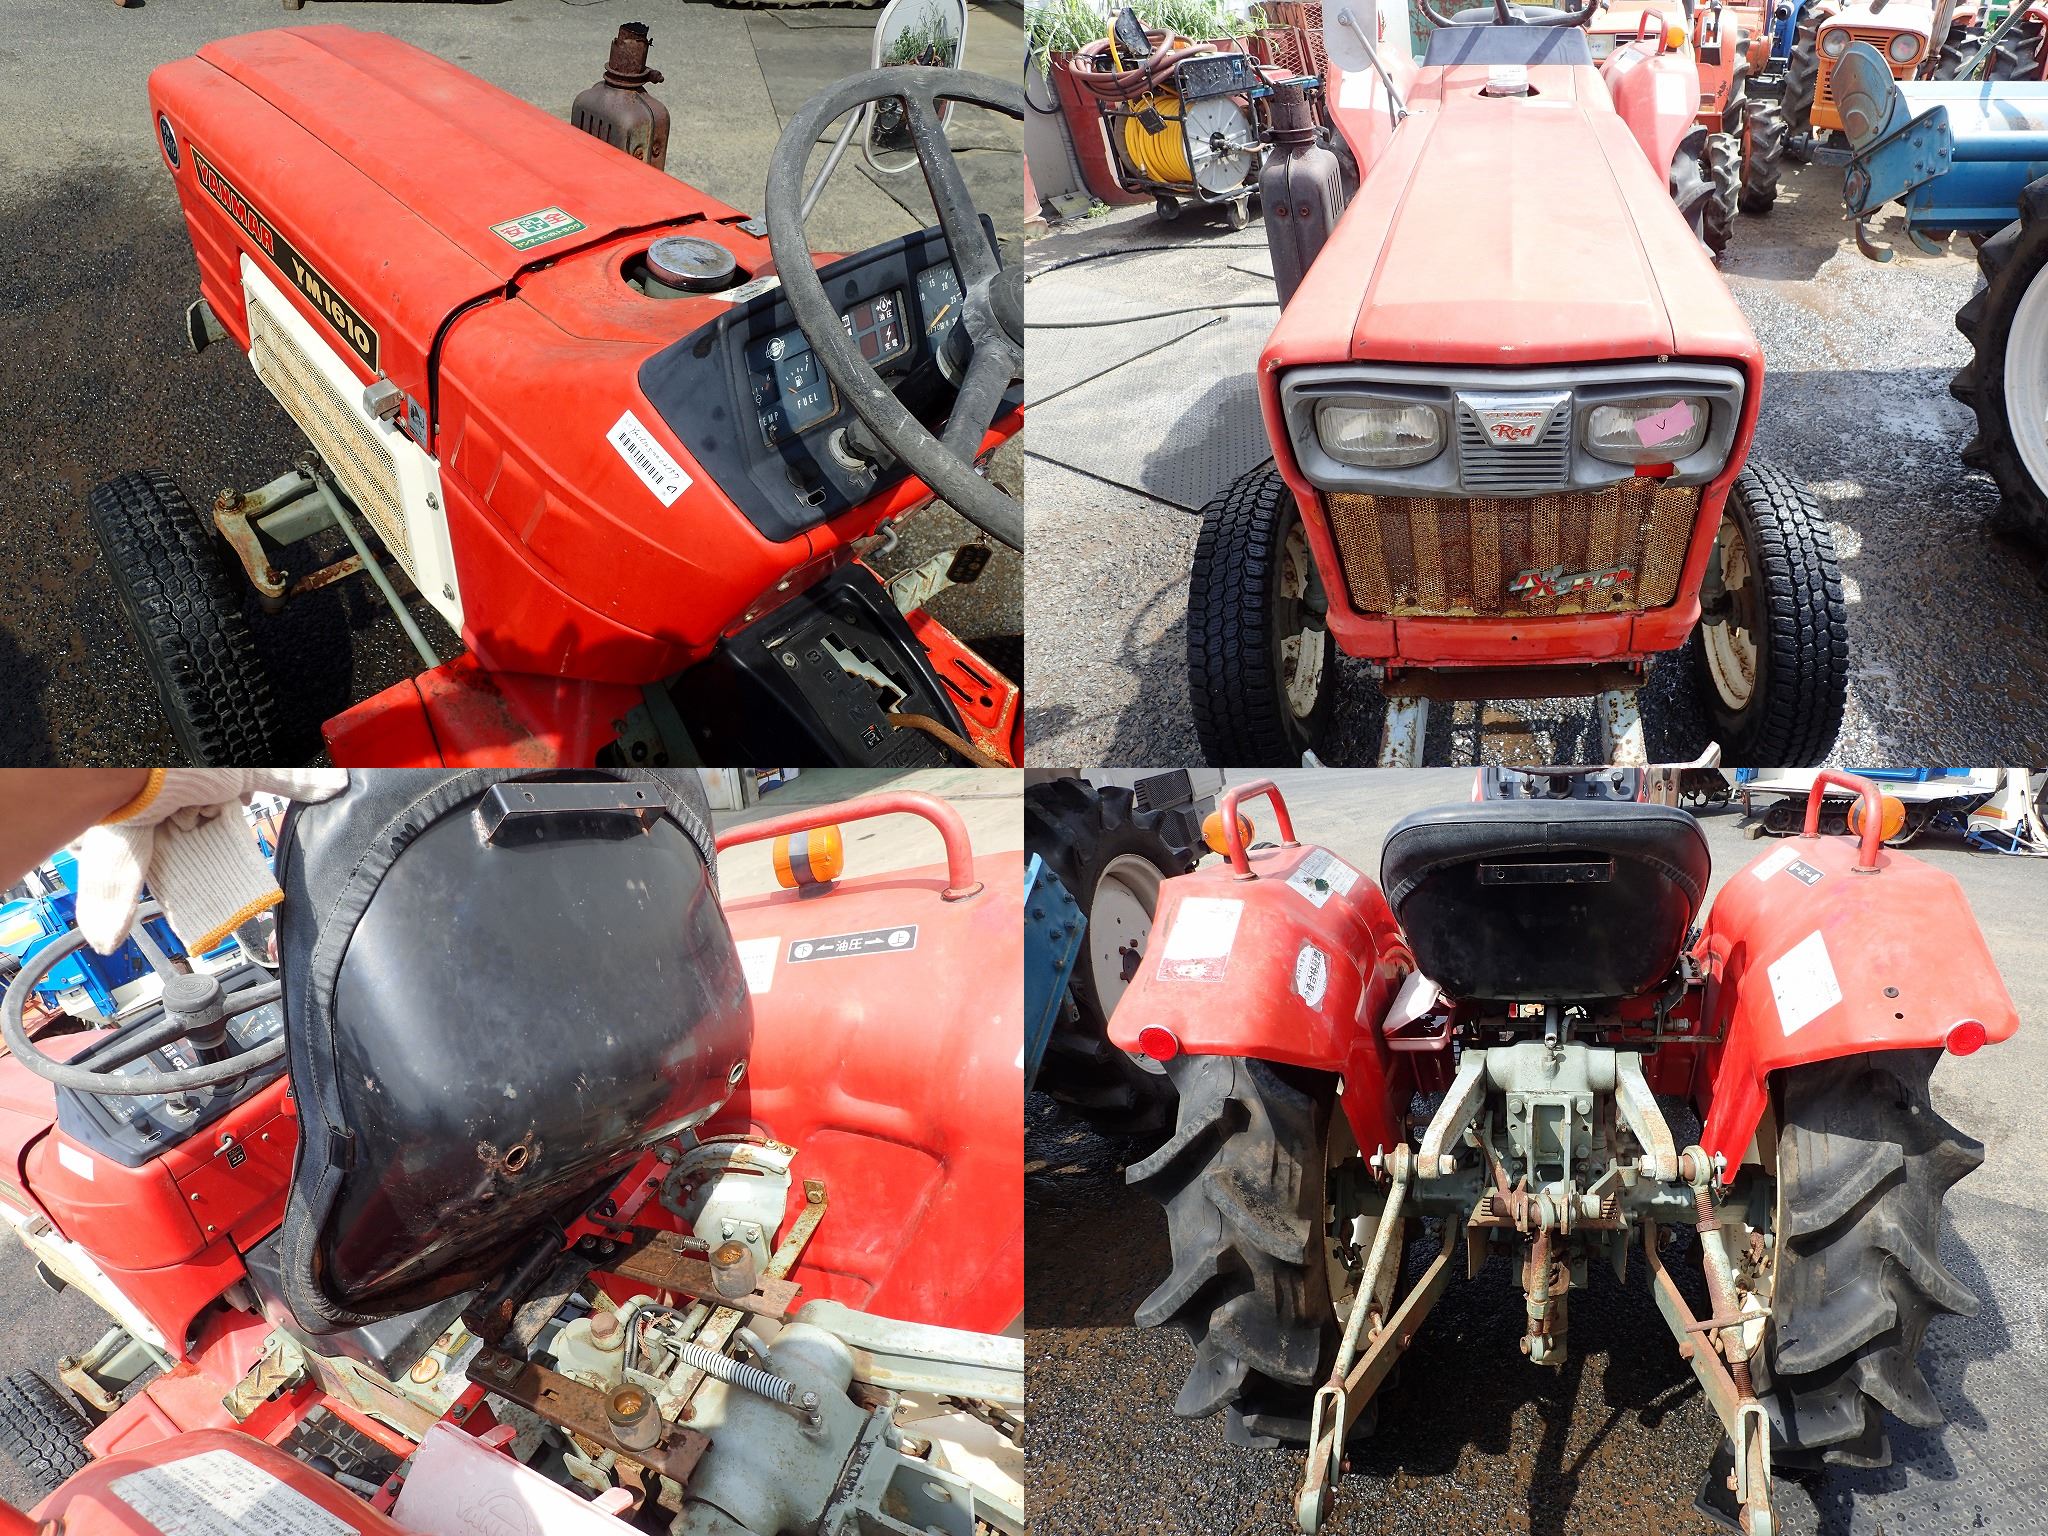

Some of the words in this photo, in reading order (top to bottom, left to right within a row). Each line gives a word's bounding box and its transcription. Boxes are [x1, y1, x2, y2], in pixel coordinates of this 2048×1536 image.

[500, 225, 524, 238] 安
[543, 212, 567, 225] 全
[197, 157, 274, 256] YANMAR
[292, 257, 370, 354] YM1610
[878, 310, 893, 322] 油圧
[884, 338, 899, 352] 充電
[797, 392, 819, 409] FUEL
[759, 411, 779, 428] TEMP
[1490, 424, 1536, 441] Red
[806, 650, 822, 663] 3
[822, 669, 837, 683] 2
[835, 937, 864, 952] 油圧
